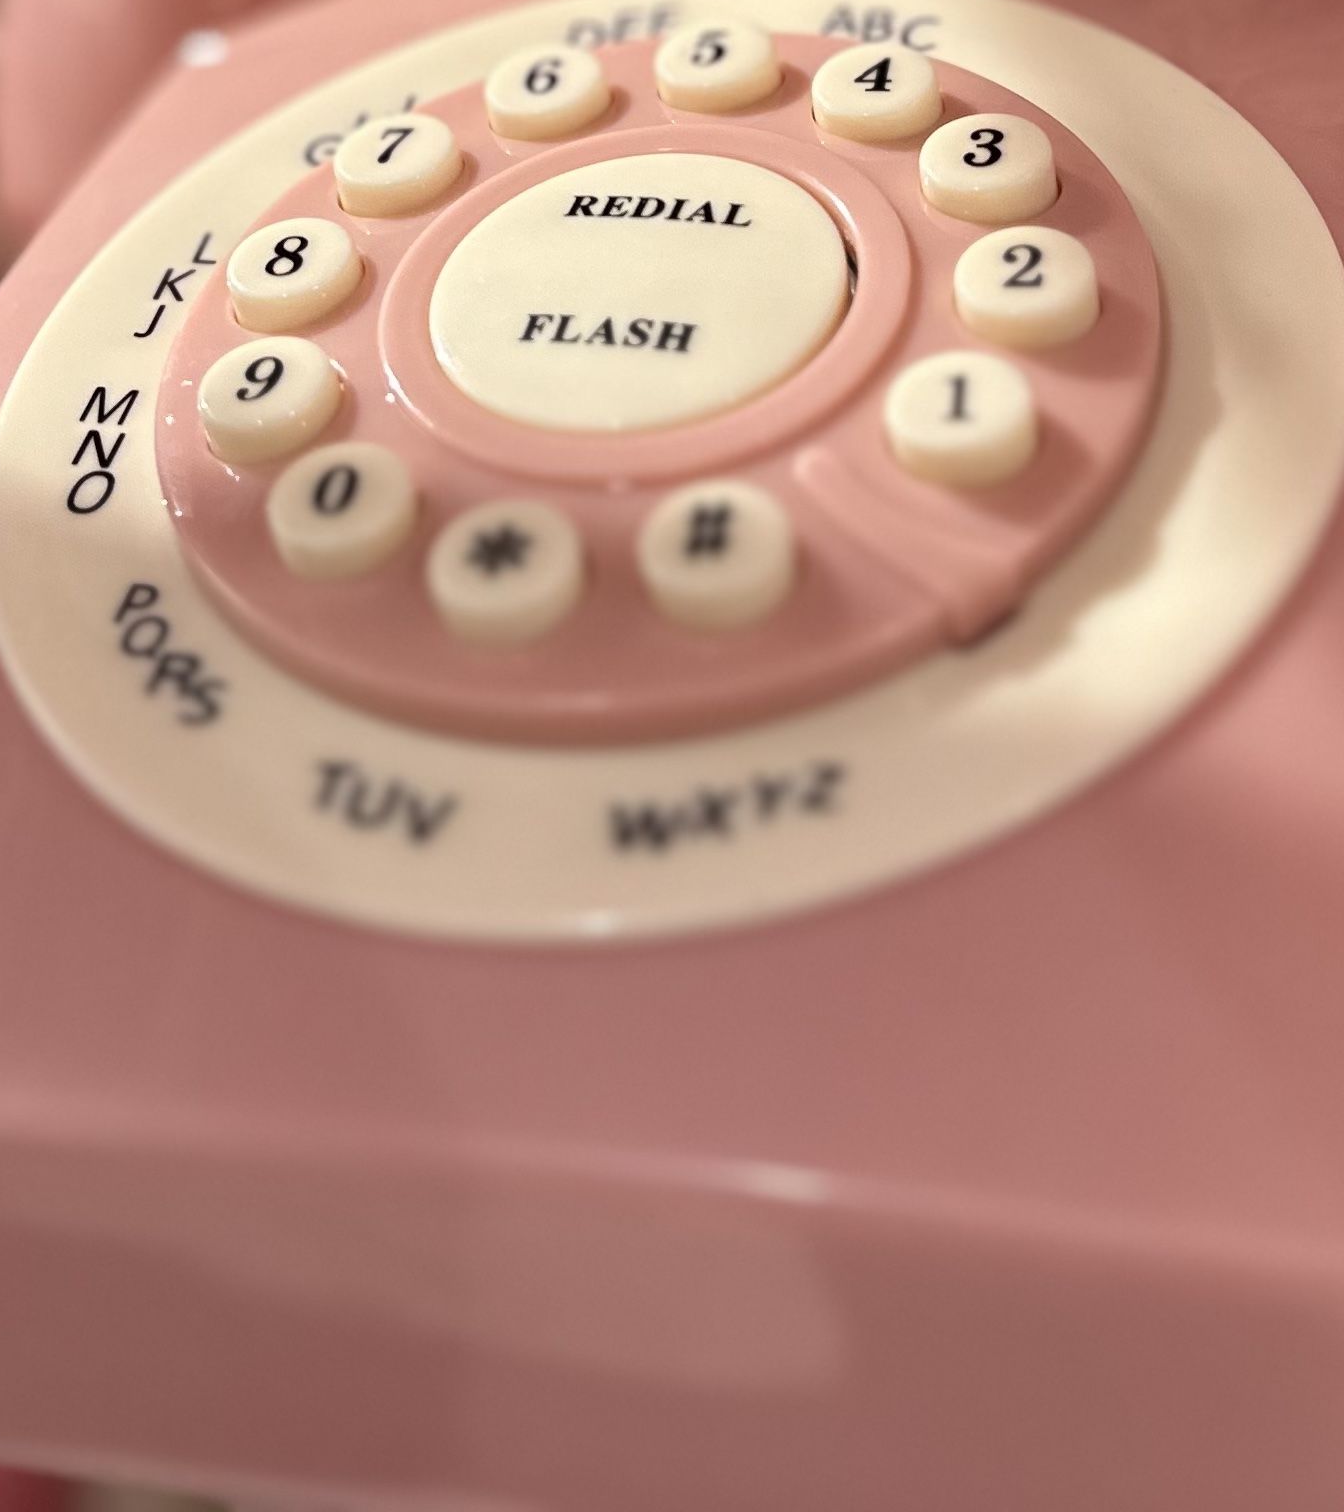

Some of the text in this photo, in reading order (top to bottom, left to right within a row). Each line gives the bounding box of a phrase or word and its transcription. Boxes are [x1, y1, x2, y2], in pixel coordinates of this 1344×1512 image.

[690, 29, 729, 66] 5
[818, 2, 940, 52] ABC
[523, 57, 561, 95] 6
[852, 56, 893, 93] 4
[376, 127, 415, 164] 7
[962, 128, 1005, 168] 3
[564, 195, 752, 228] REDIAL
[264, 235, 309, 277] 8
[1001, 244, 1045, 289] 2
[518, 312, 697, 353] FLASH
[235, 355, 285, 402] 9
[939, 372, 973, 425] 1
[66, 386, 141, 517] MNO
[310, 465, 361, 516] 0
[680, 502, 734, 563] #
[112, 582, 230, 727] PQRS
[309, 758, 458, 846] TUV
[608, 762, 846, 854] WXYZ
